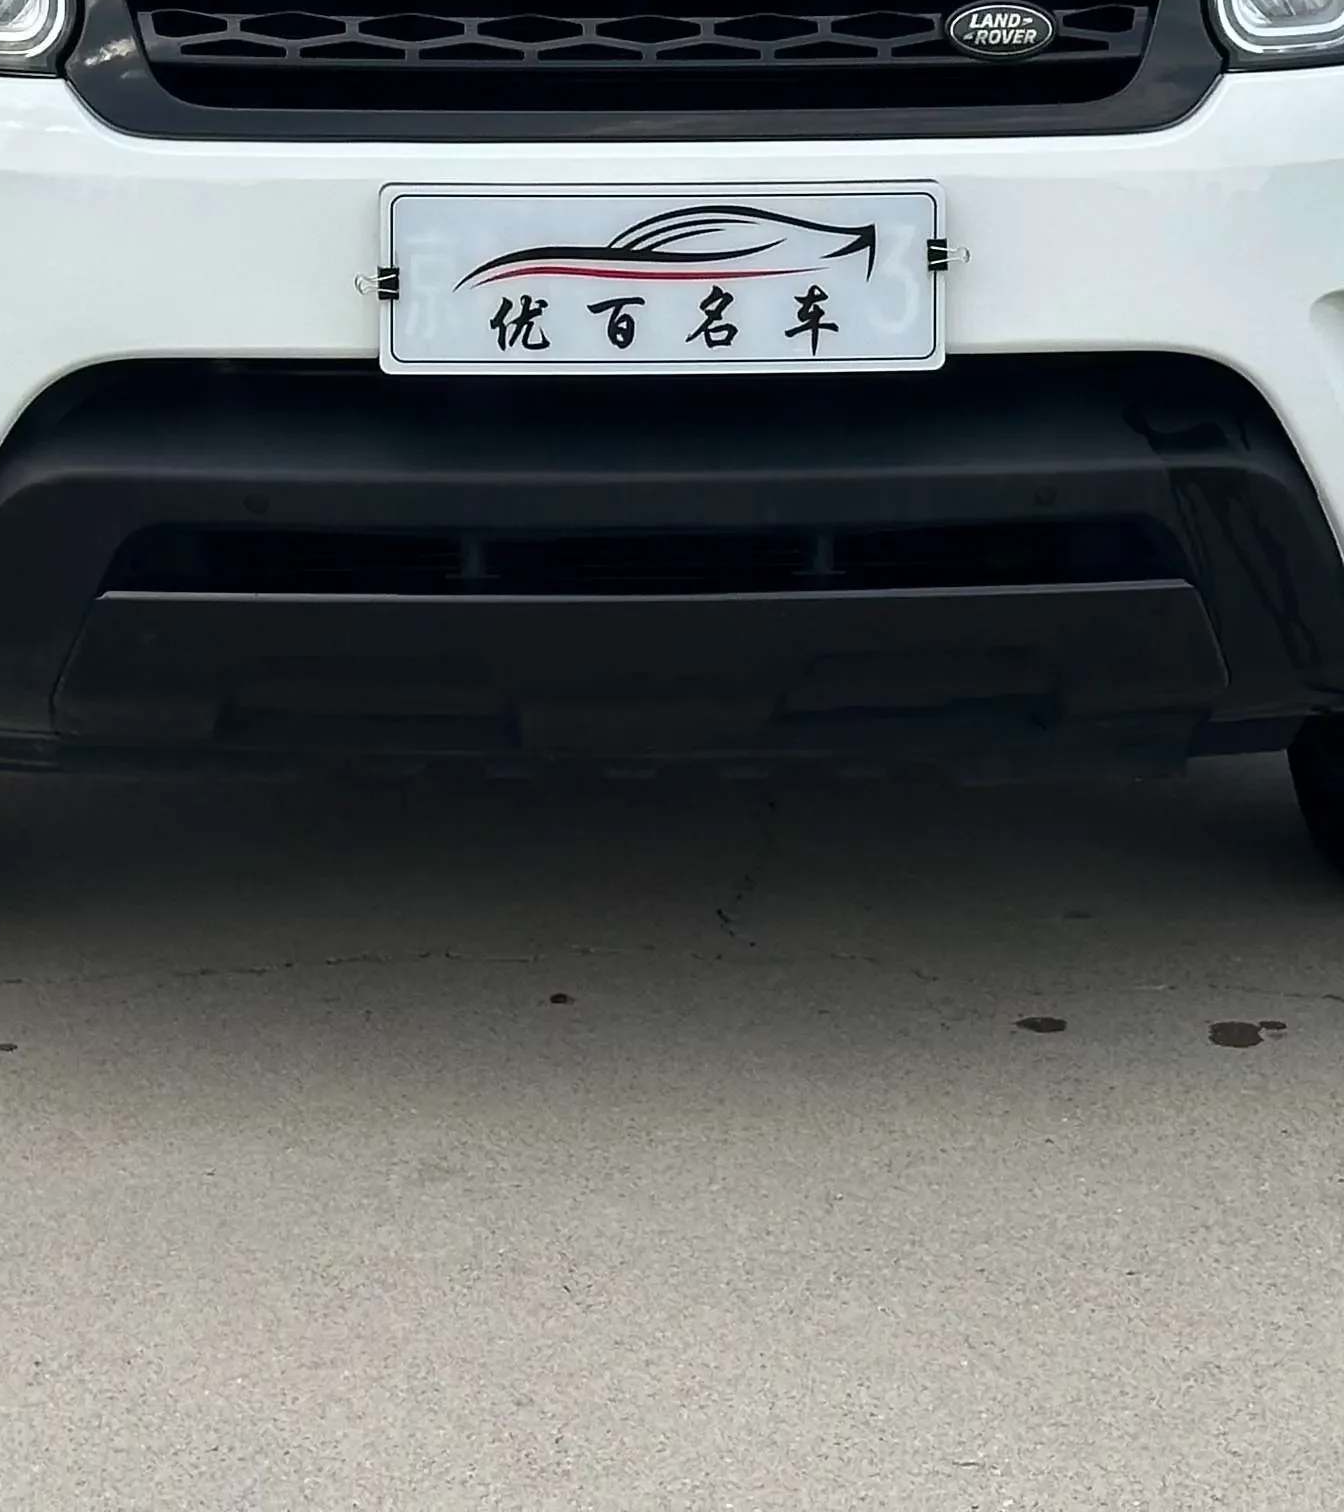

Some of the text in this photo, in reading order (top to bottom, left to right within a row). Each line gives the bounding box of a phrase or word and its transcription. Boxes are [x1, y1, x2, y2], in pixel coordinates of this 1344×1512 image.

[969, 13, 1021, 28] LAND
[975, 29, 1037, 44] ROVER
[490, 284, 839, 356] 优百名车
